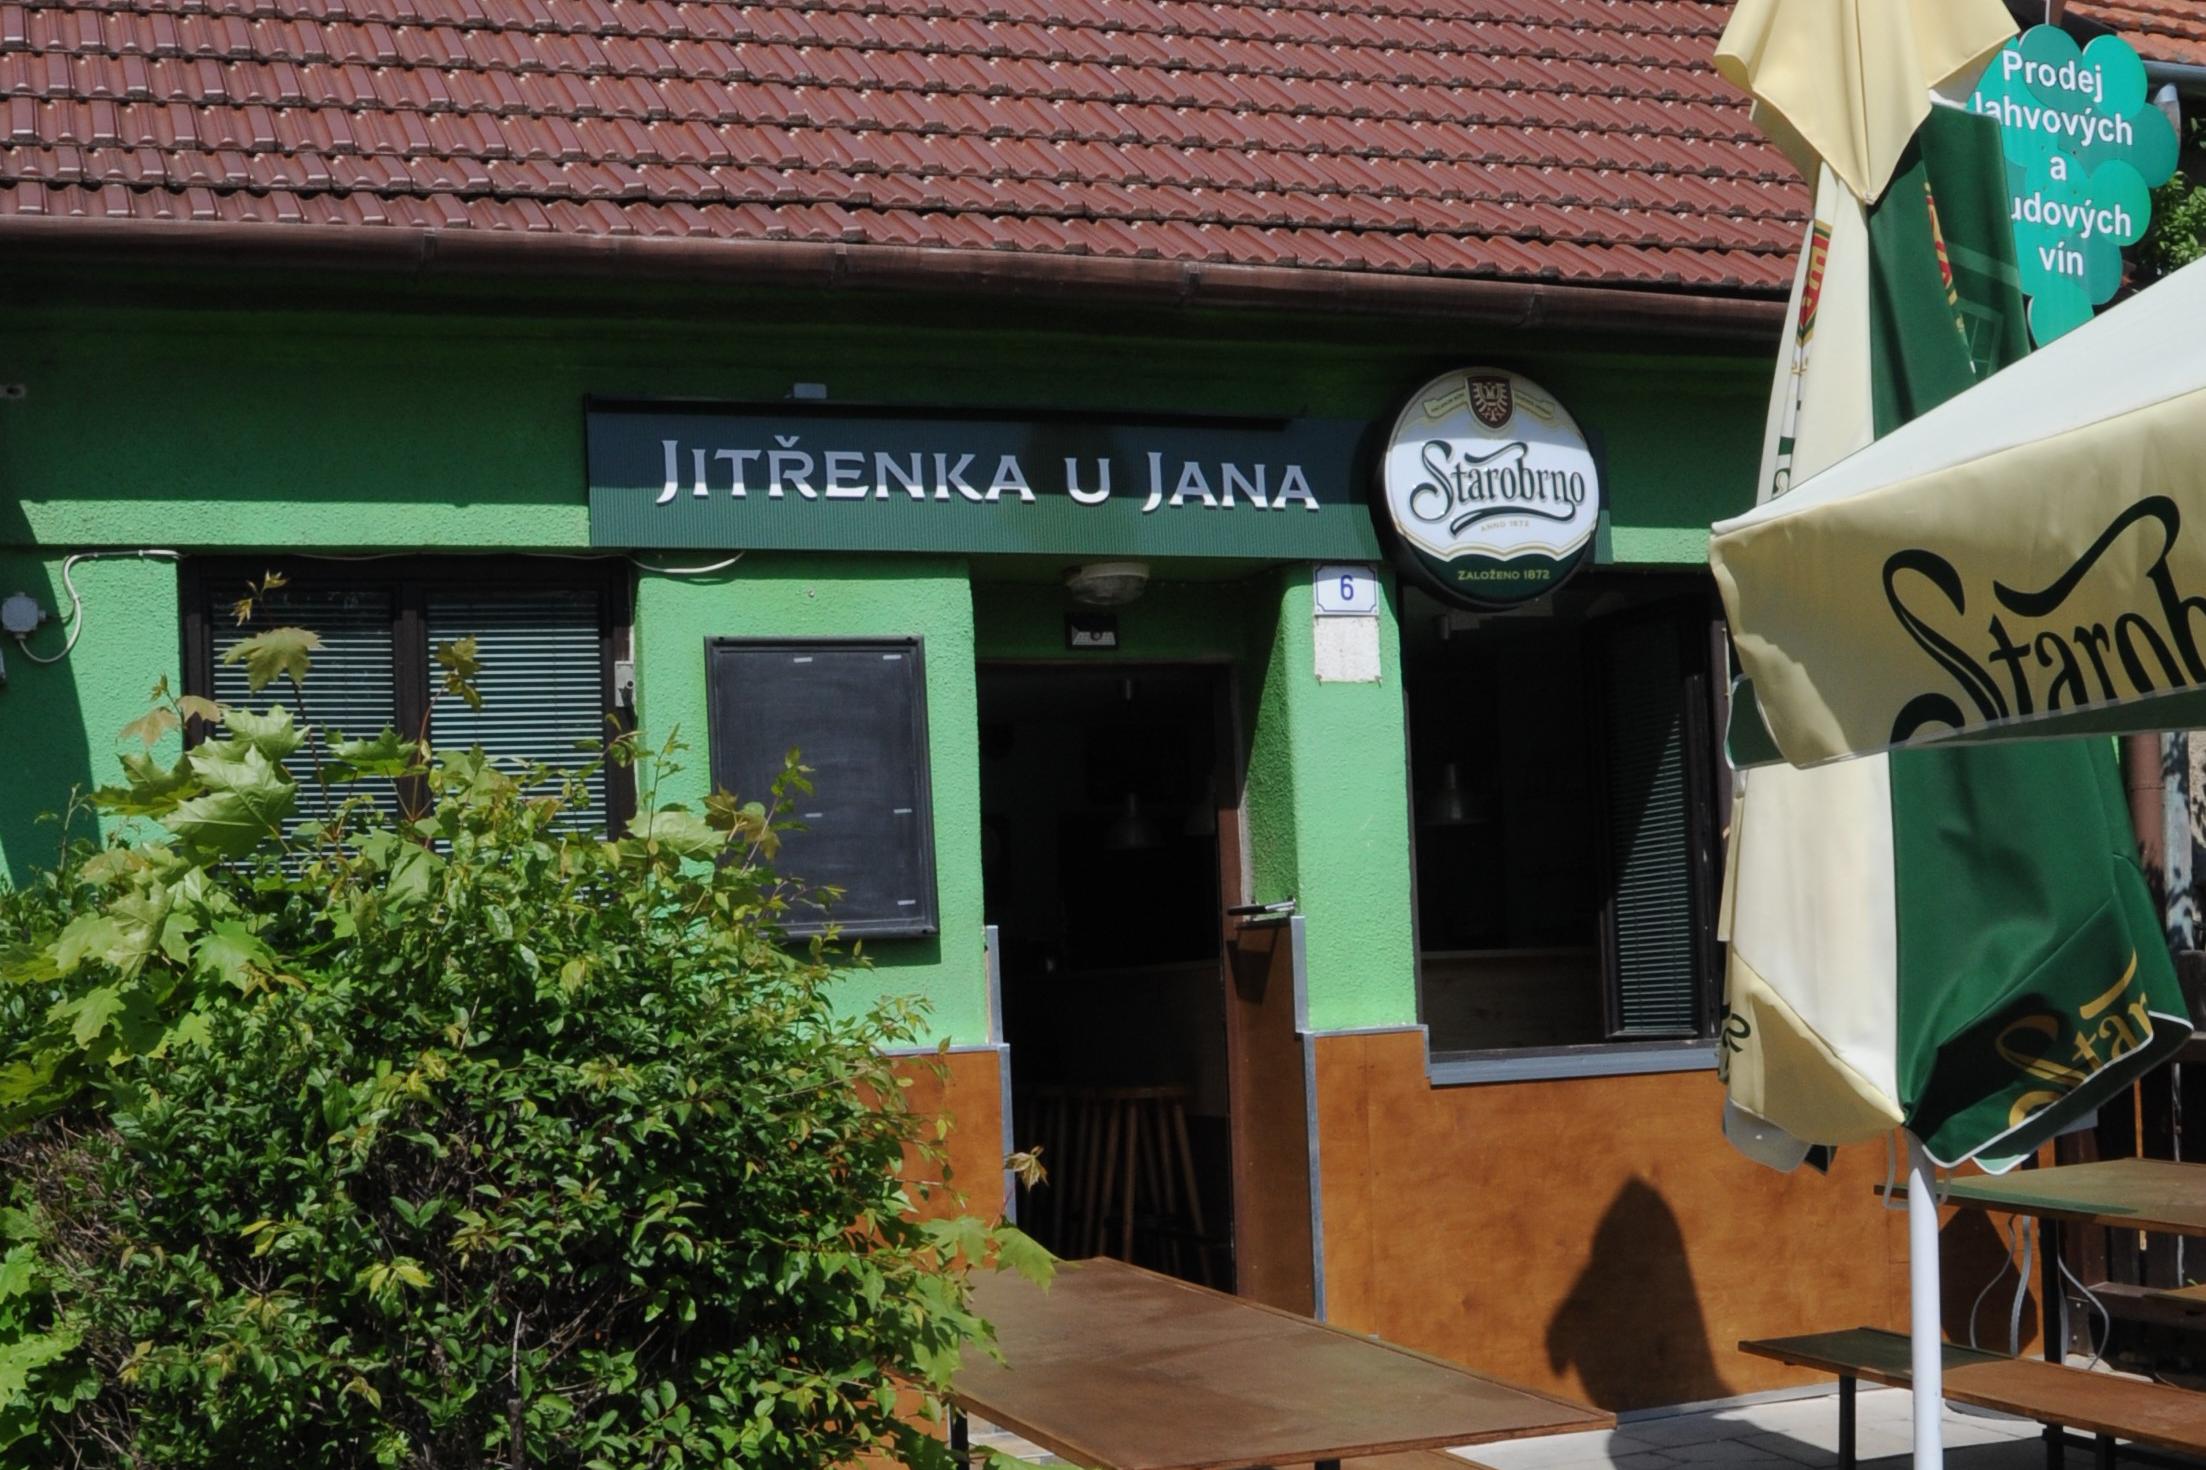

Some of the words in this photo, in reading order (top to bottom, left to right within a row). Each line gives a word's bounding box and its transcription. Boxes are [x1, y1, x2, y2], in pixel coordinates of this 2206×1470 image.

[2002, 49, 2103, 104] Prodej
[2049, 156, 2067, 181] a
[2038, 241, 2084, 277] vín
[655, 435, 1036, 505] JITŘENKA
[1064, 457, 1111, 504] U
[1141, 451, 1321, 513] JANA
[1409, 439, 1586, 537] Starobrno
[1339, 573, 1355, 601] 6
[1457, 568, 1521, 581] ZALOŽENO
[1523, 568, 1551, 580] 1872
